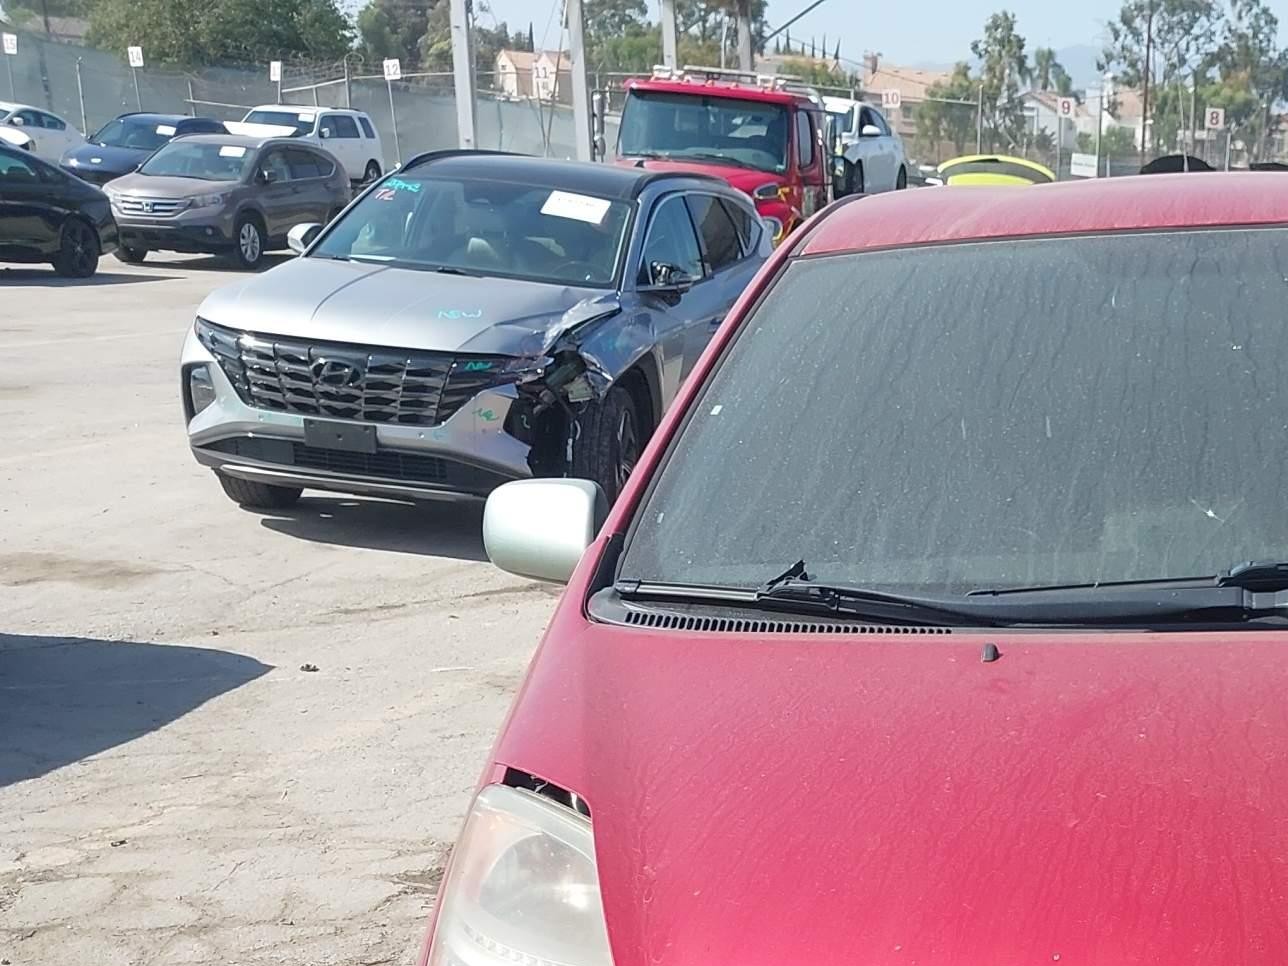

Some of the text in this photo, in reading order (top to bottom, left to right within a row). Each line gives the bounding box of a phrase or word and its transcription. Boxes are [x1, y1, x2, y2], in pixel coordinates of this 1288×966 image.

[385, 63, 400, 76] 12
[535, 66, 549, 79] 11
[884, 92, 899, 105] 10
[1061, 100, 1071, 115] 9
[1209, 111, 1220, 126] 8
